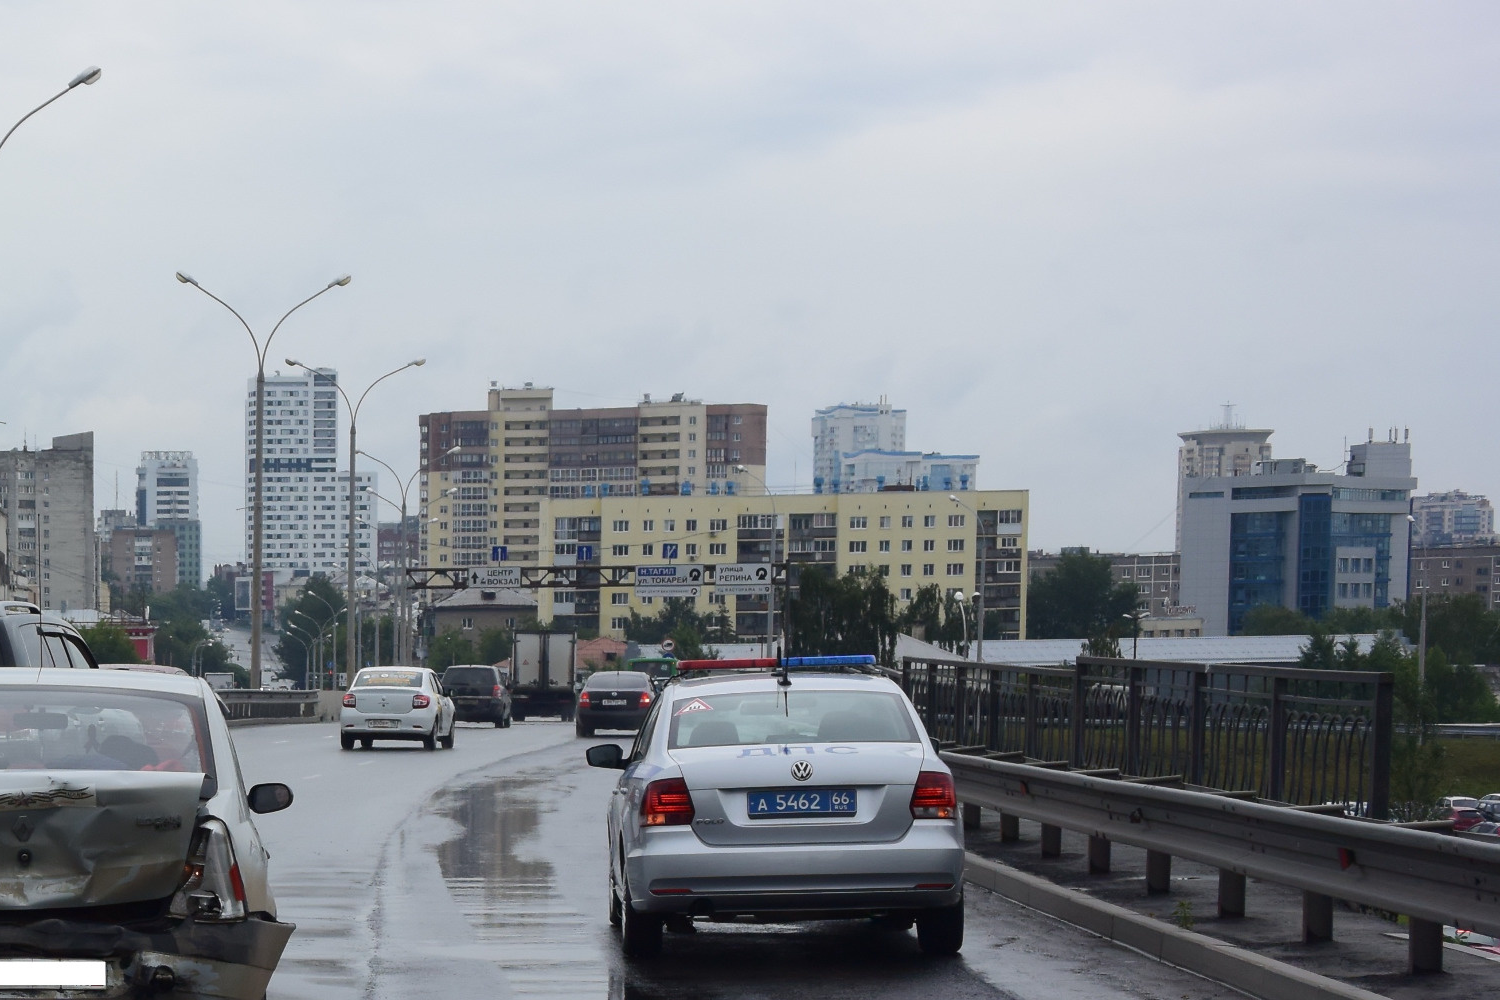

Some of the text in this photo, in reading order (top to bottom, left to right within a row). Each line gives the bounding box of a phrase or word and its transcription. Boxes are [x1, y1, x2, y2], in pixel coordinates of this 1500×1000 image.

[487, 569, 514, 577] ЦЕНТР
[719, 566, 744, 574] улица
[651, 576, 688, 584] ТОКАРЕЙ
[719, 574, 753, 582] РЕПИНА
[736, 746, 859, 758] ДПС
[776, 793, 821, 810] 5462
[832, 792, 850, 804] 66
[696, 817, 725, 825] POLO
